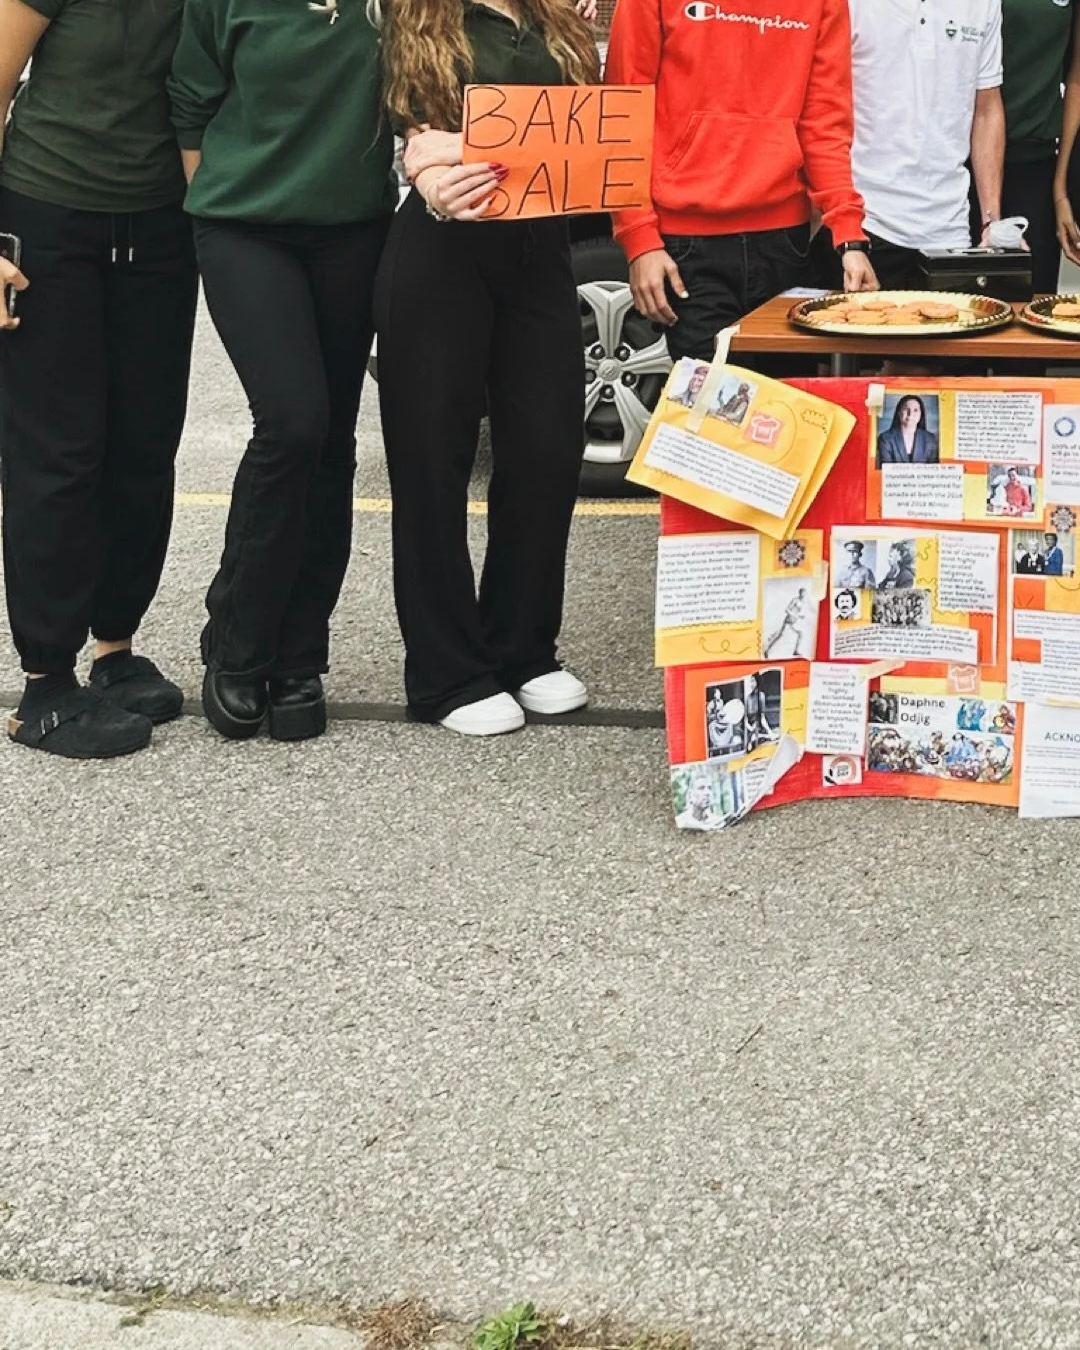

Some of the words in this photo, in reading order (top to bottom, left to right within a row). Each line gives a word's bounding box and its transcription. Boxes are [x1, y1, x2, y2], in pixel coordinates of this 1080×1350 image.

[685, 1, 809, 34] Champion
[465, 86, 642, 149] BAKE
[901, 697, 945, 709] Daphne
[901, 713, 930, 726] Odjig
